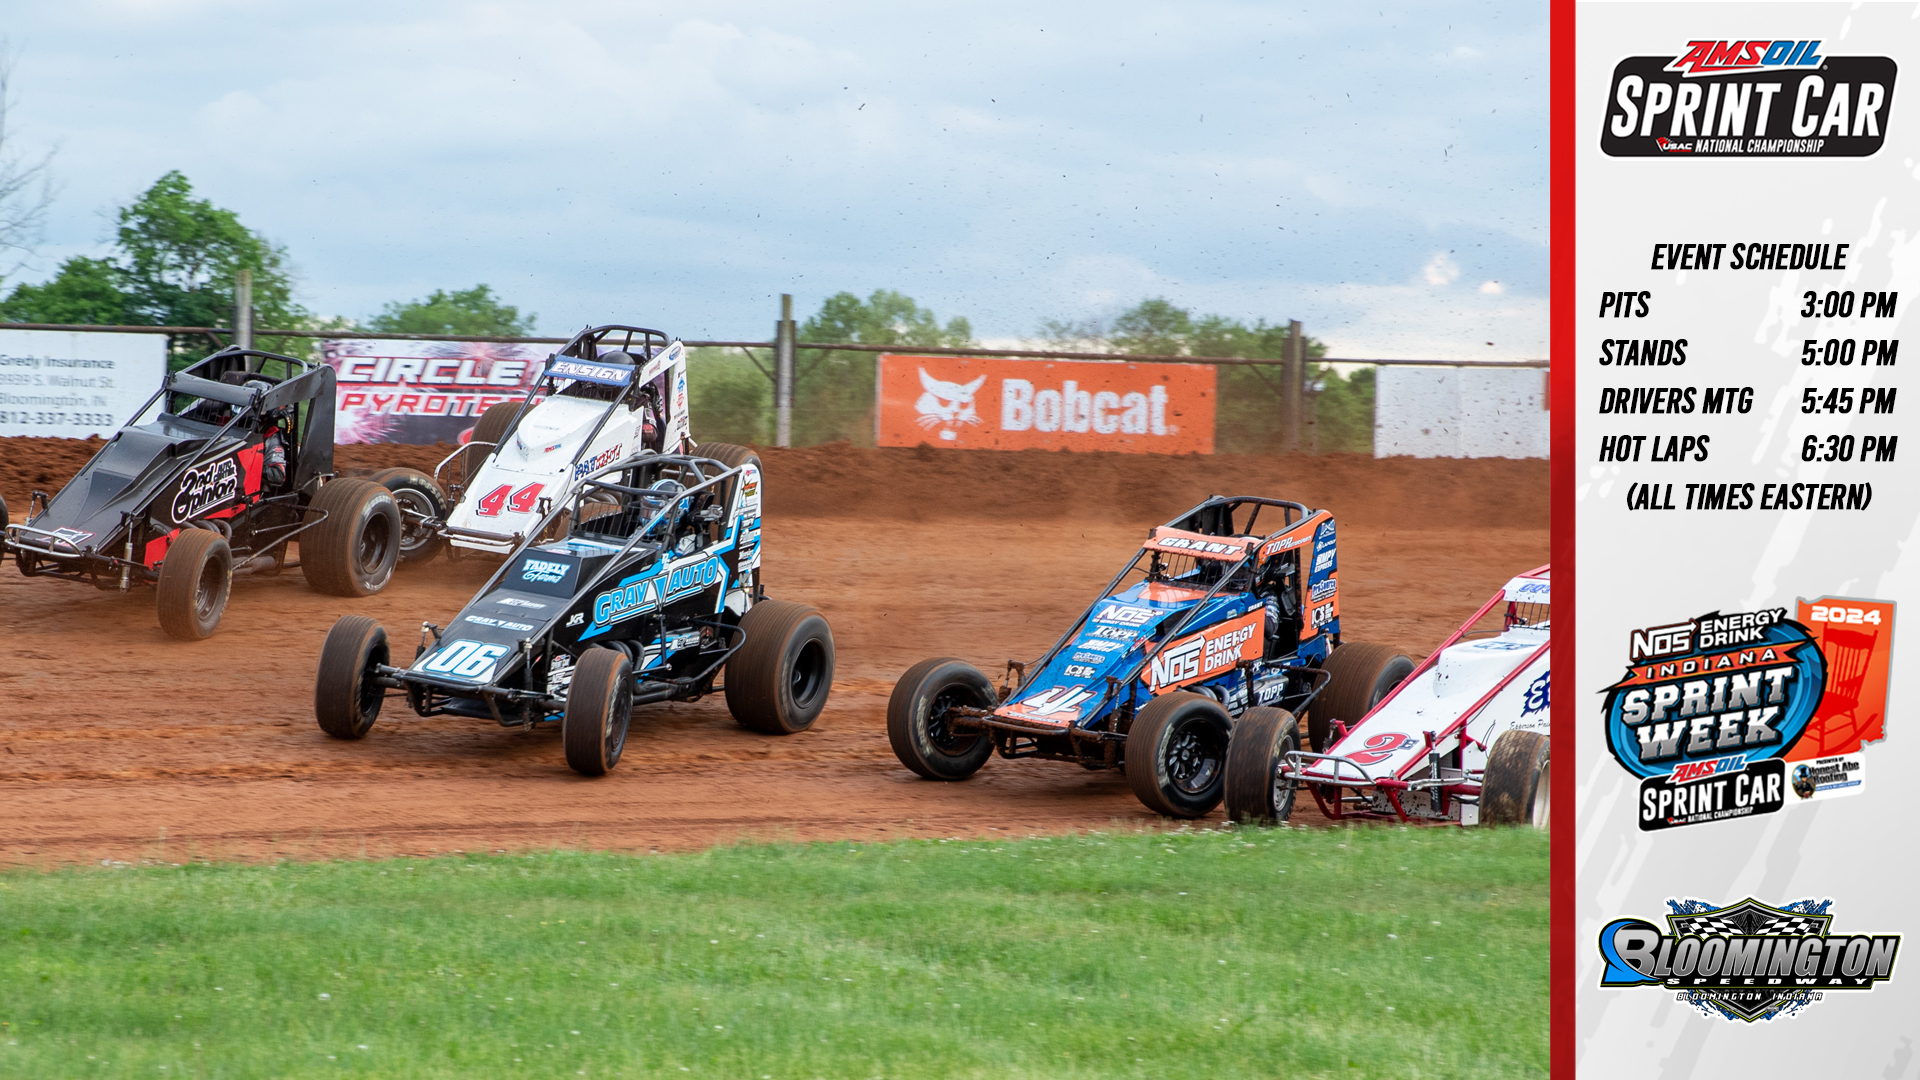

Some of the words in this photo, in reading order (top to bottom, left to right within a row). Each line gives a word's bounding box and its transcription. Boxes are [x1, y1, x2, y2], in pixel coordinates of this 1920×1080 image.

[44, 355, 115, 369] Insurance
[338, 356, 531, 386] CIRCLE
[549, 361, 631, 382] ENSIGN
[1001, 378, 1169, 436] Bobcat
[574, 443, 622, 481] PATRIOT
[476, 482, 547, 518] 44
[1156, 536, 1243, 555] GRANT
[1266, 536, 1294, 555] TOPP
[521, 558, 572, 577] FADELY
[594, 577, 649, 627] GRAY
[669, 554, 720, 596] AUTO
[465, 615, 498, 626] GRAY
[501, 620, 535, 632] AUTO
[1094, 604, 1160, 624] NOS
[1204, 622, 1258, 657] ENERGY
[423, 639, 510, 678] 06
[1150, 634, 1207, 694] NOS
[1203, 643, 1244, 674] DRINK
[1257, 683, 1284, 706] TOPP
